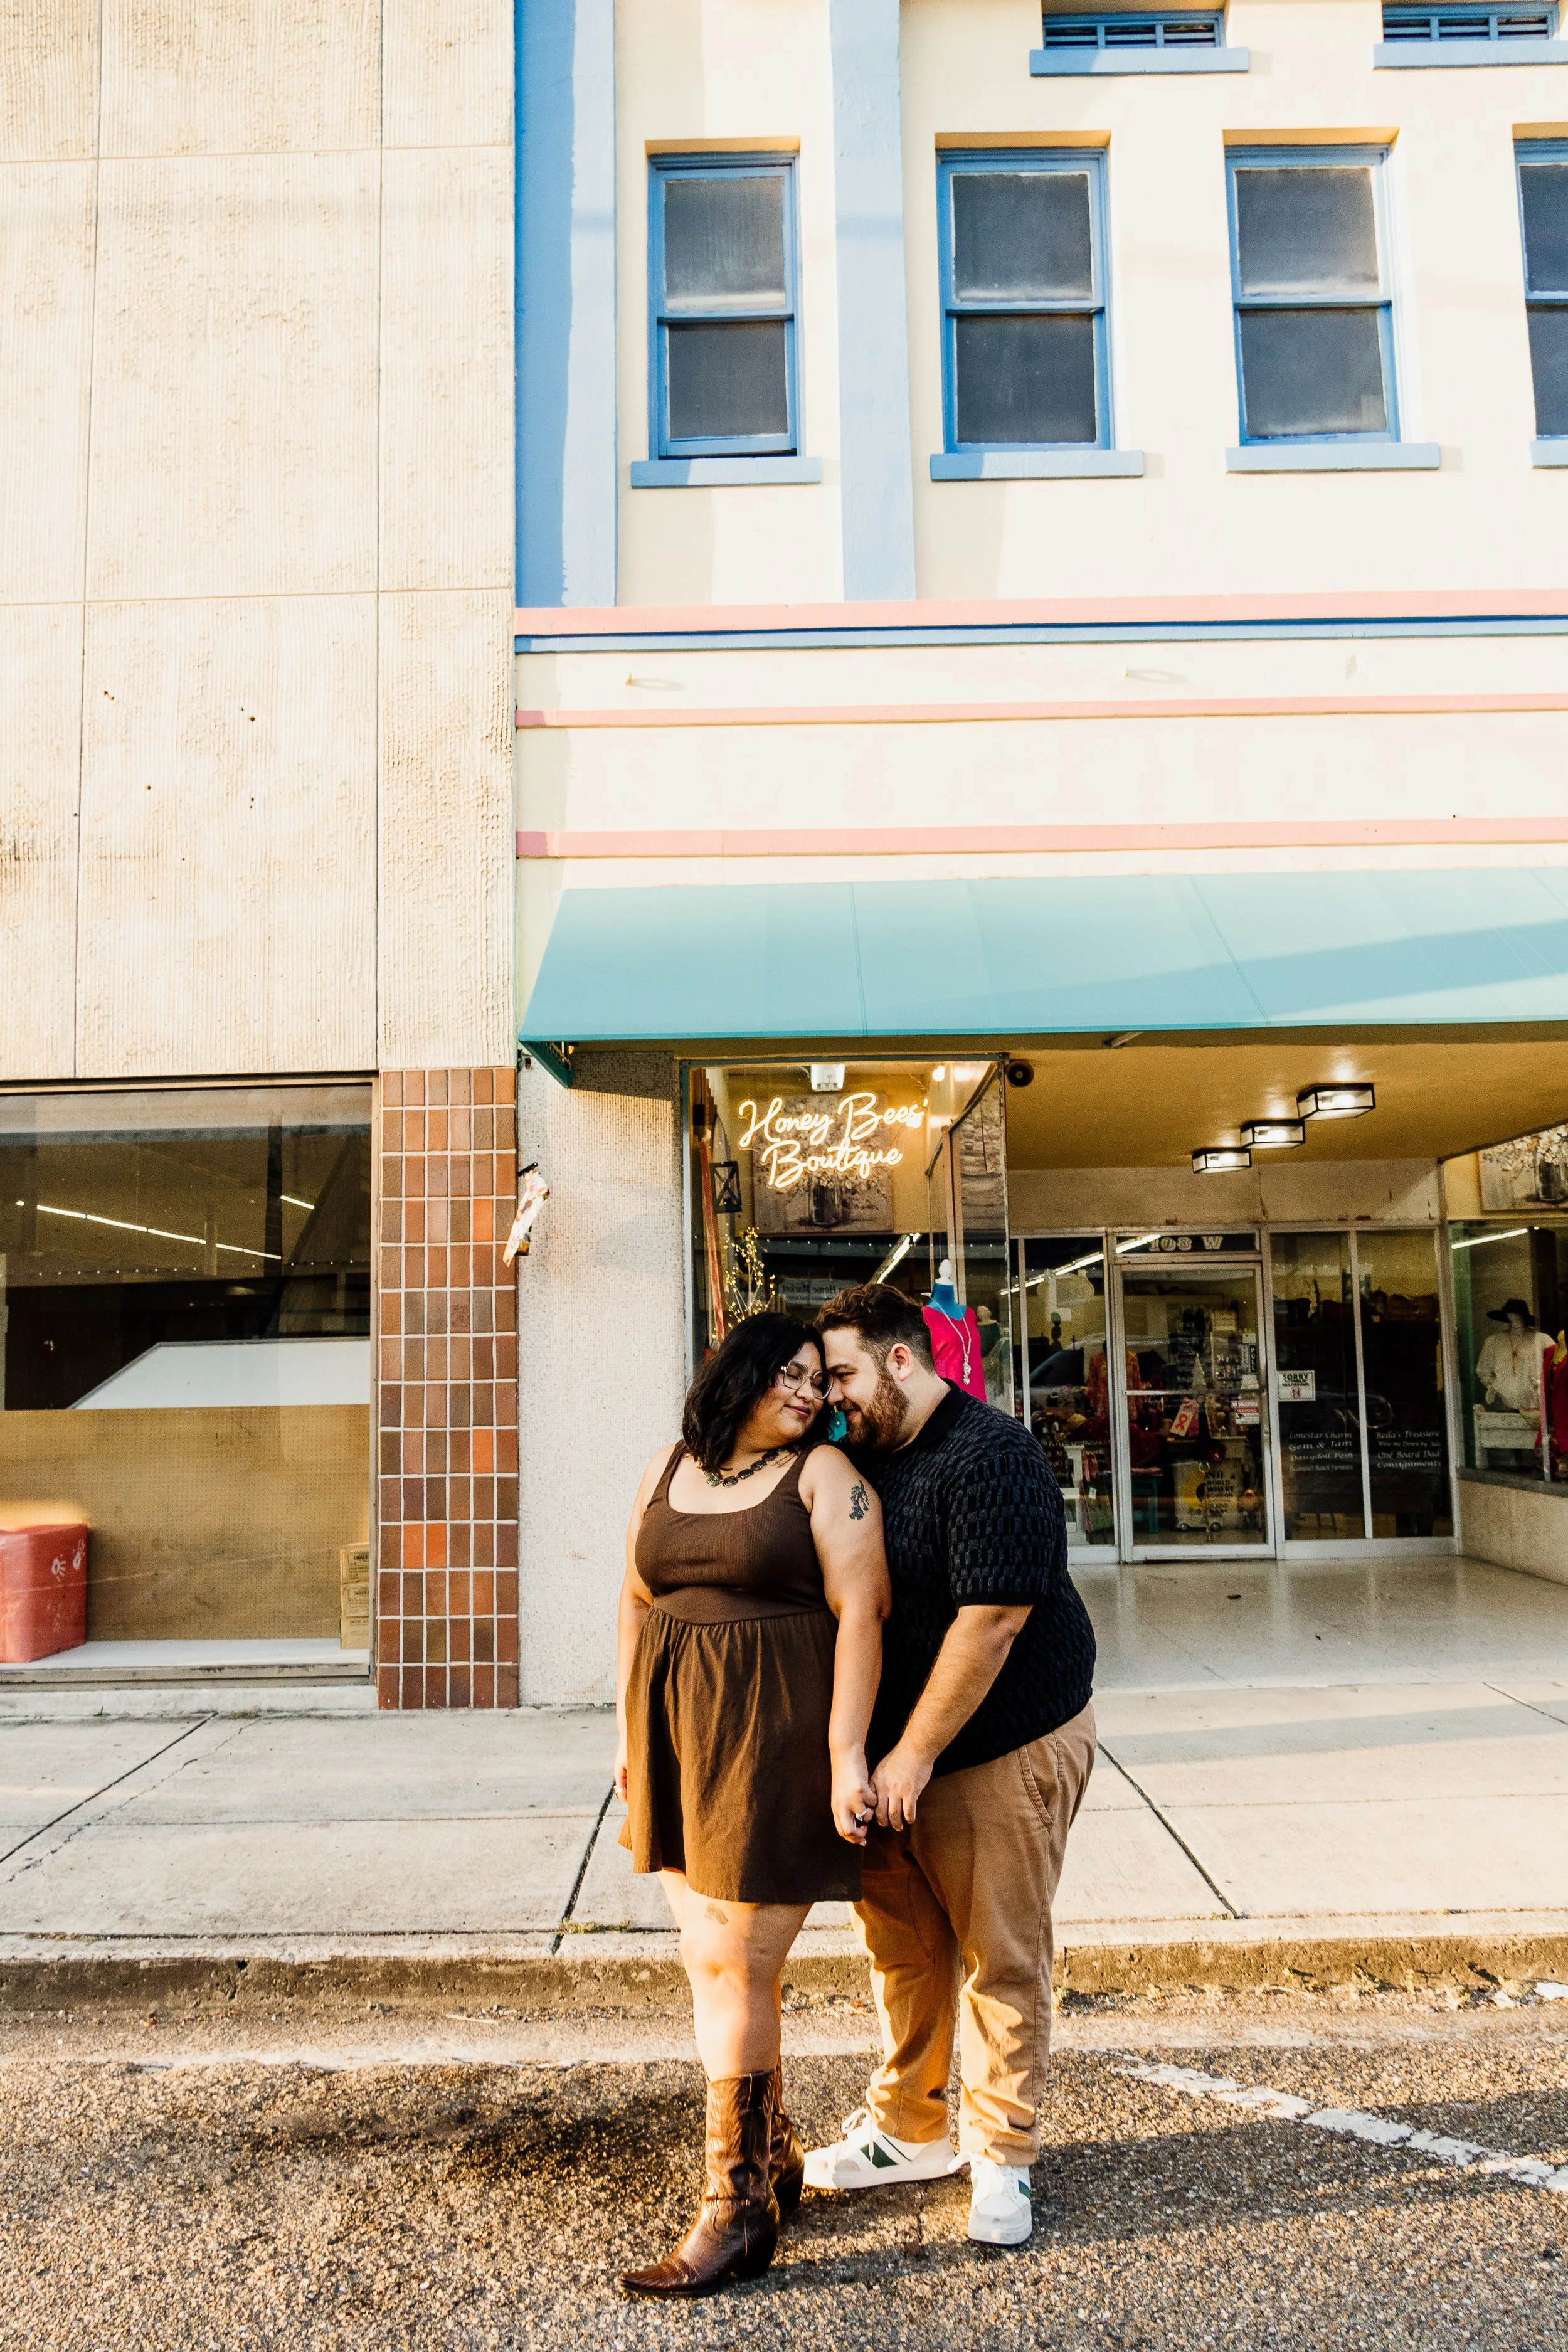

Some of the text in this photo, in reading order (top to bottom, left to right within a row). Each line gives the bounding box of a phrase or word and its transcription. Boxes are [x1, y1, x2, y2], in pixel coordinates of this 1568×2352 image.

[738, 1097, 834, 1147] Honey
[761, 1137, 903, 1188] Boutique
[1148, 1235, 1223, 1252] 108 W
[1376, 1461, 1442, 1470] Consignments
